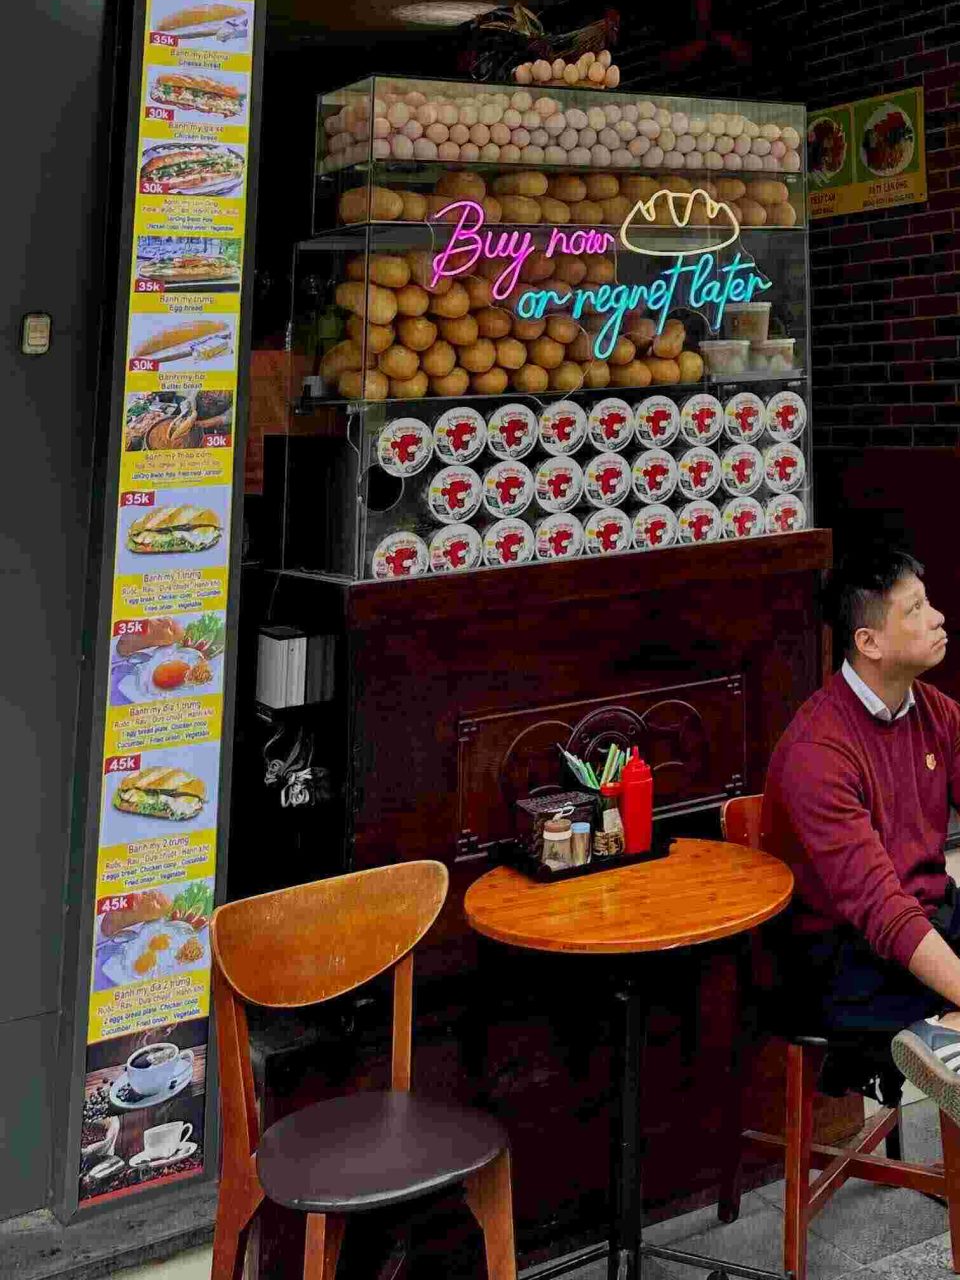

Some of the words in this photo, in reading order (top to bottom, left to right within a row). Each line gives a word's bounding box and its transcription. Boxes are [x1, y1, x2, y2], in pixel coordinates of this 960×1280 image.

[153, 34, 174, 45] 35k
[149, 108, 169, 119] 30k
[142, 183, 163, 193] 30k
[430, 200, 536, 300] Buy
[546, 228, 616, 258] now
[138, 282, 161, 292] 35k
[517, 287, 573, 320] or
[572, 255, 693, 360] regret
[688, 253, 773, 334] later
[132, 360, 153, 371] 30k
[206, 436, 227, 447] 30k
[125, 493, 150, 505] 35k
[118, 621, 142, 634] 35k
[109, 758, 135, 770] 45k
[101, 898, 128, 911] 45k
